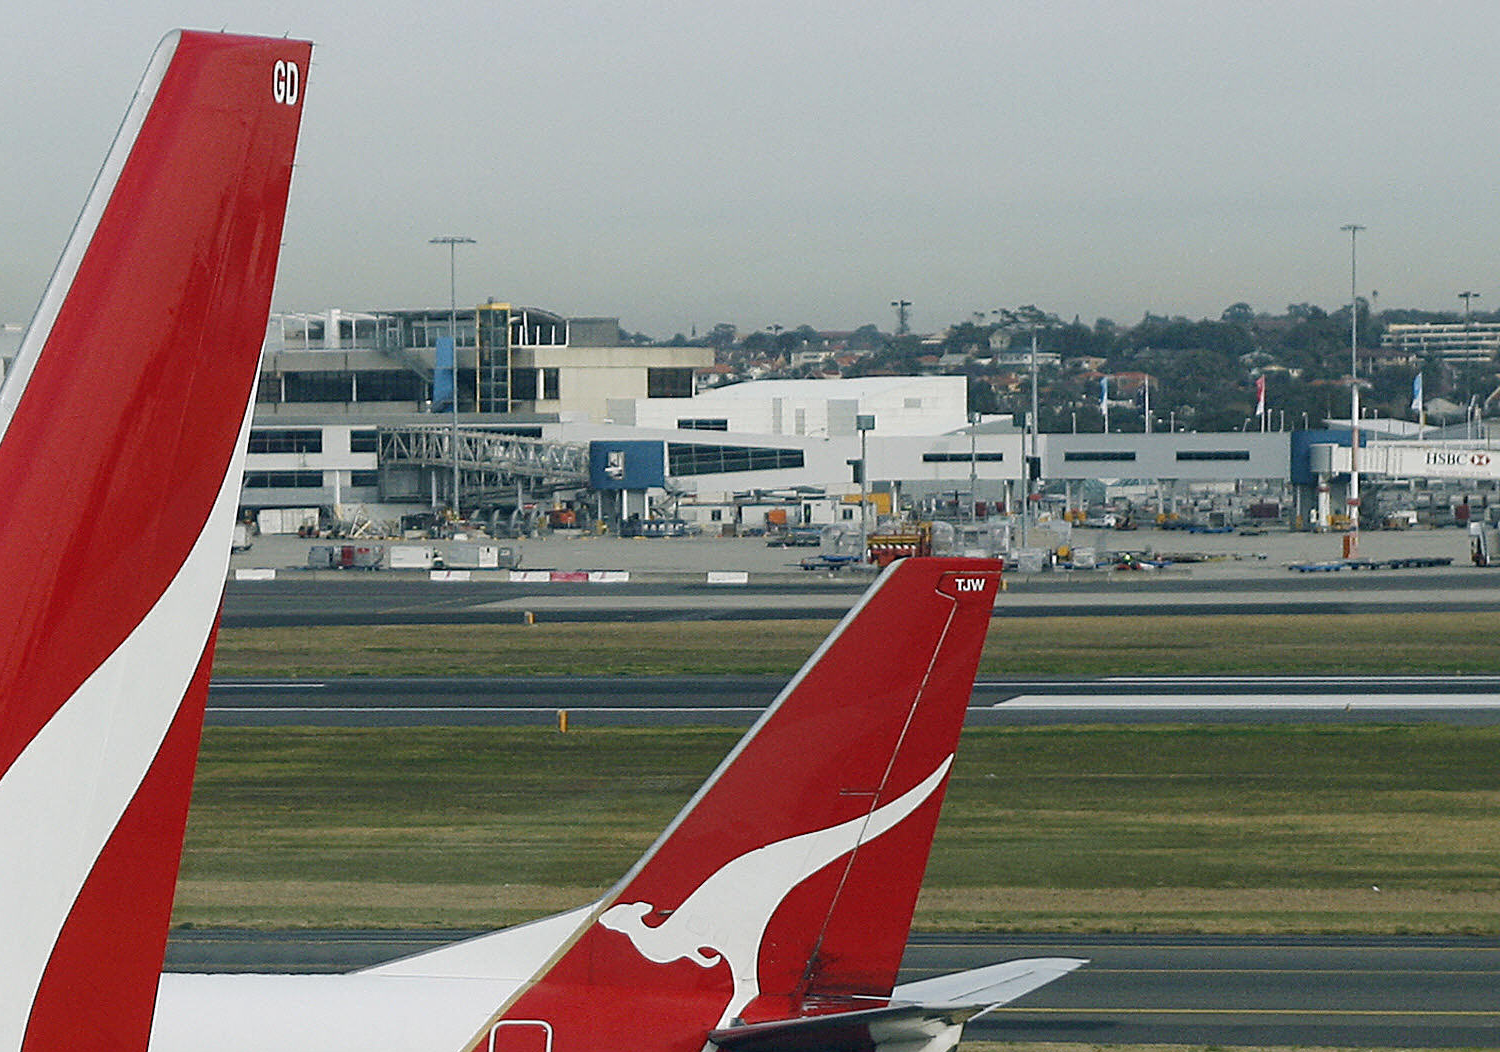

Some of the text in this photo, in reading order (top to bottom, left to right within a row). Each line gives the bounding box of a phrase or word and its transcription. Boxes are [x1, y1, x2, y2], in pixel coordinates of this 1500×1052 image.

[273, 59, 299, 106] GD
[1426, 452, 1468, 465] HSBC
[955, 578, 985, 592] TJW
